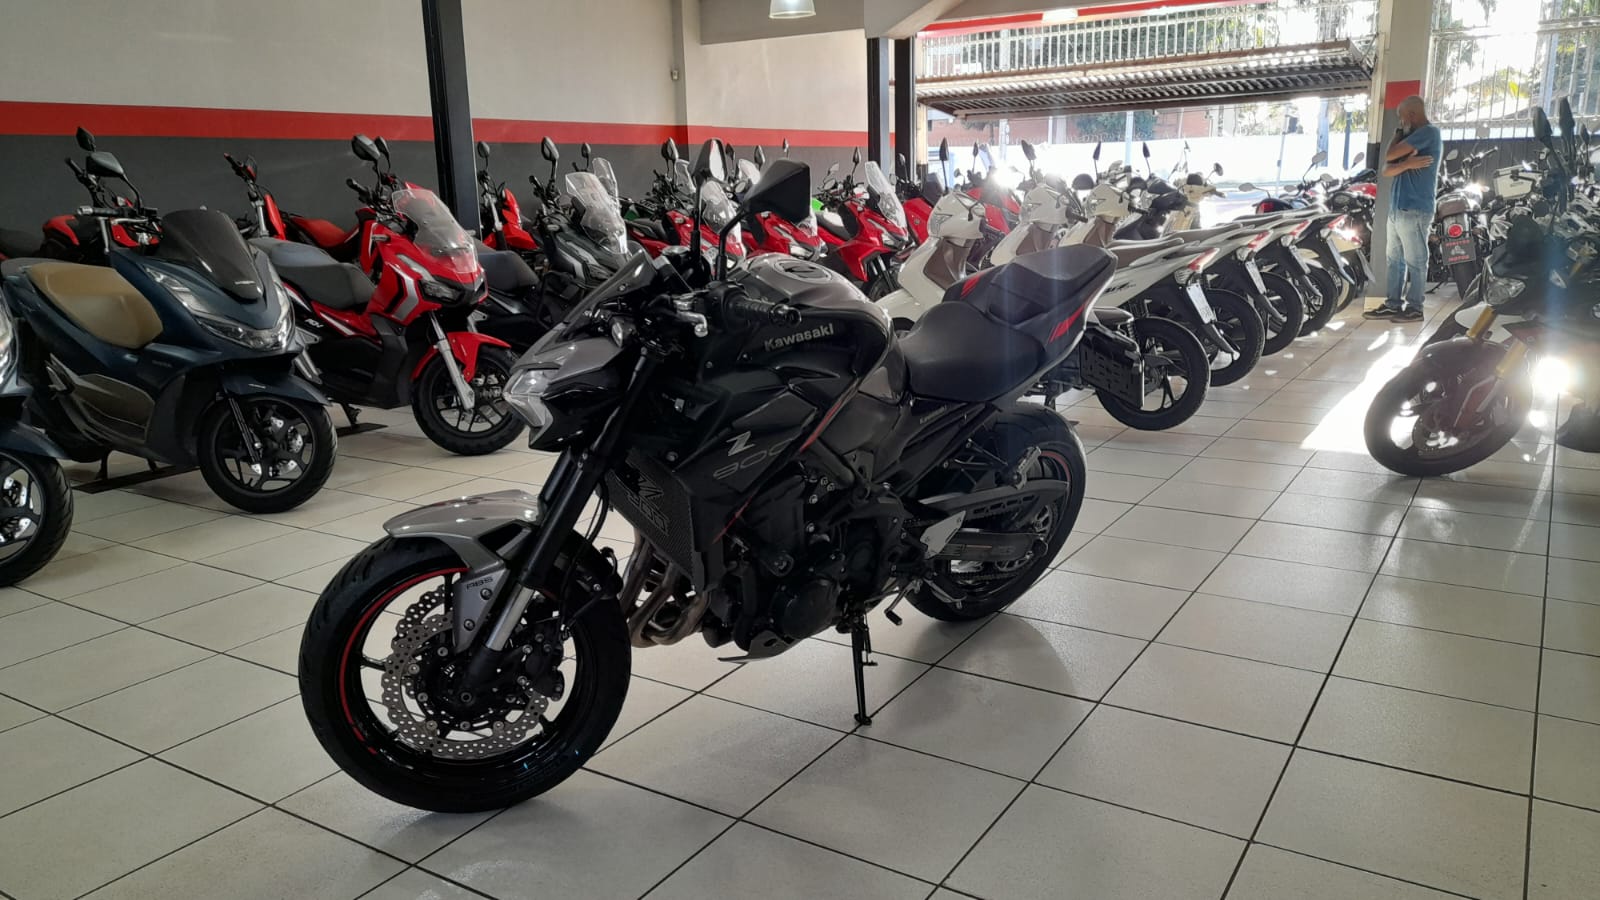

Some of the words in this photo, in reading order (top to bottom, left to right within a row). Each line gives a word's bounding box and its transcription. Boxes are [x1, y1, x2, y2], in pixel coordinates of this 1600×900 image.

[764, 323, 834, 352] Kawasaki
[726, 431, 756, 457] Z
[713, 439, 792, 480] 900
